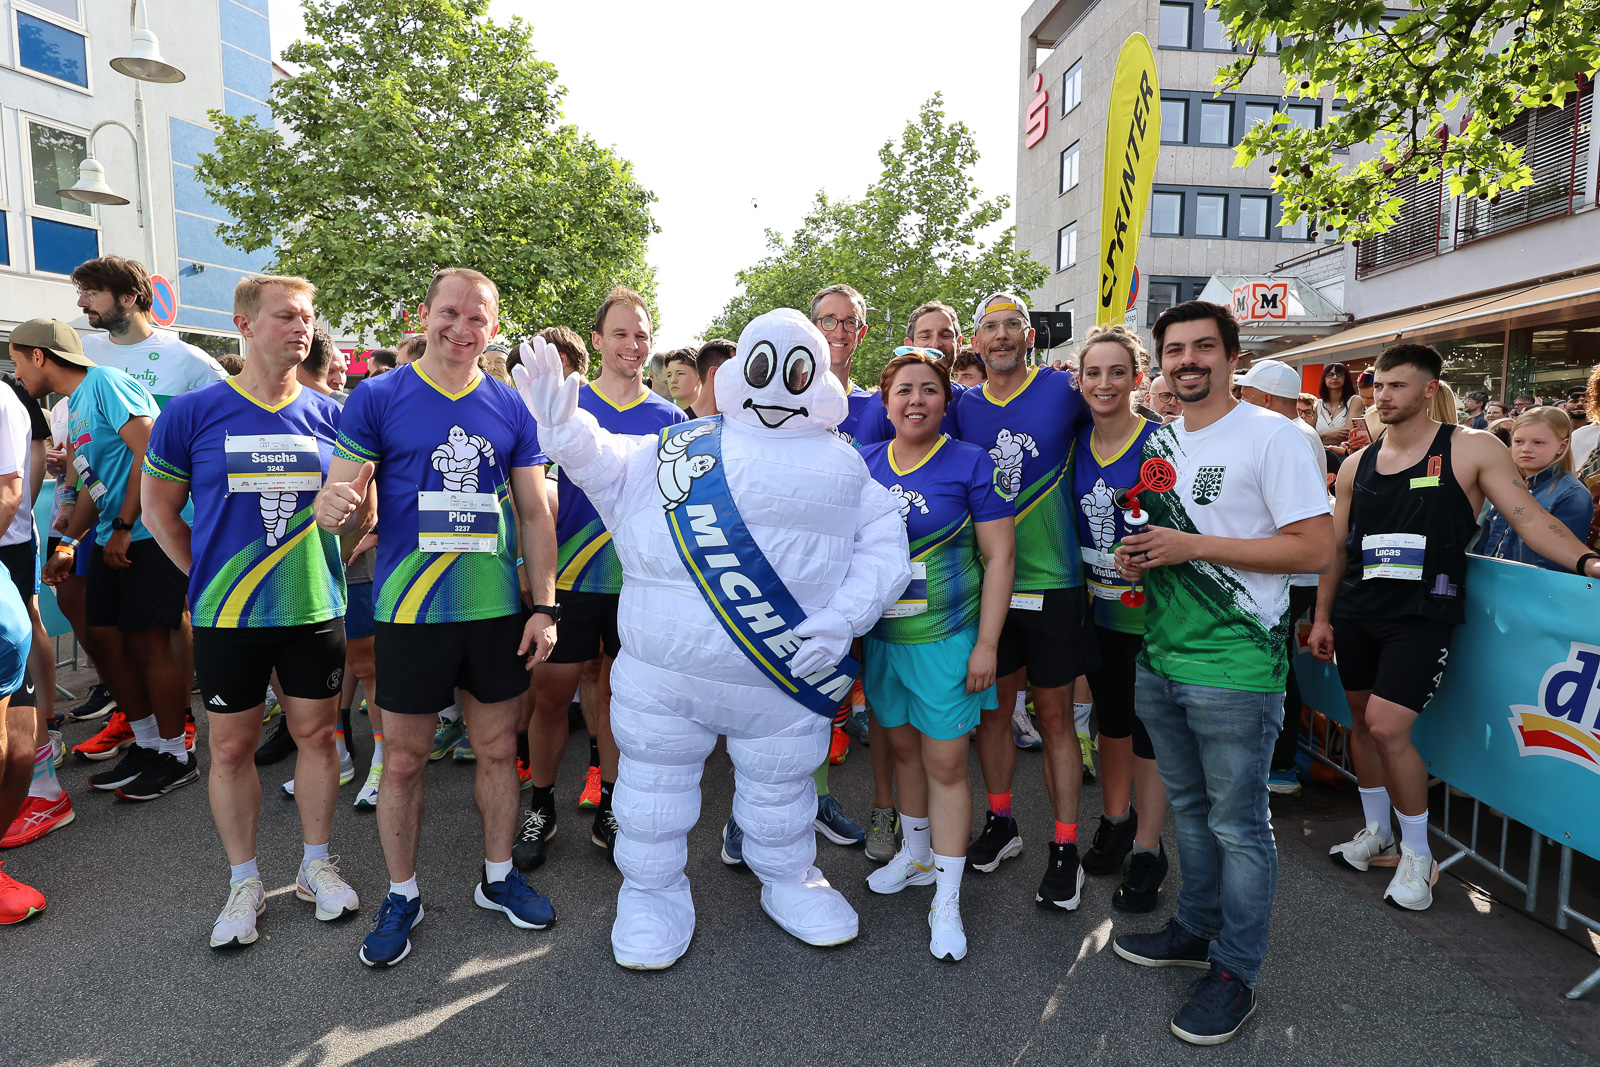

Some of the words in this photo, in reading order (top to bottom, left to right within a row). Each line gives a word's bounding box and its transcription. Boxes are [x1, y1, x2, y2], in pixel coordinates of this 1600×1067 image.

[1236, 295, 1246, 312] M
[1260, 293, 1279, 309] M
[251, 452, 298, 463] Sascha
[448, 511, 477, 523] Piotr
[1375, 548, 1401, 557] Lucas
[686, 504, 855, 703] MICHEIN
